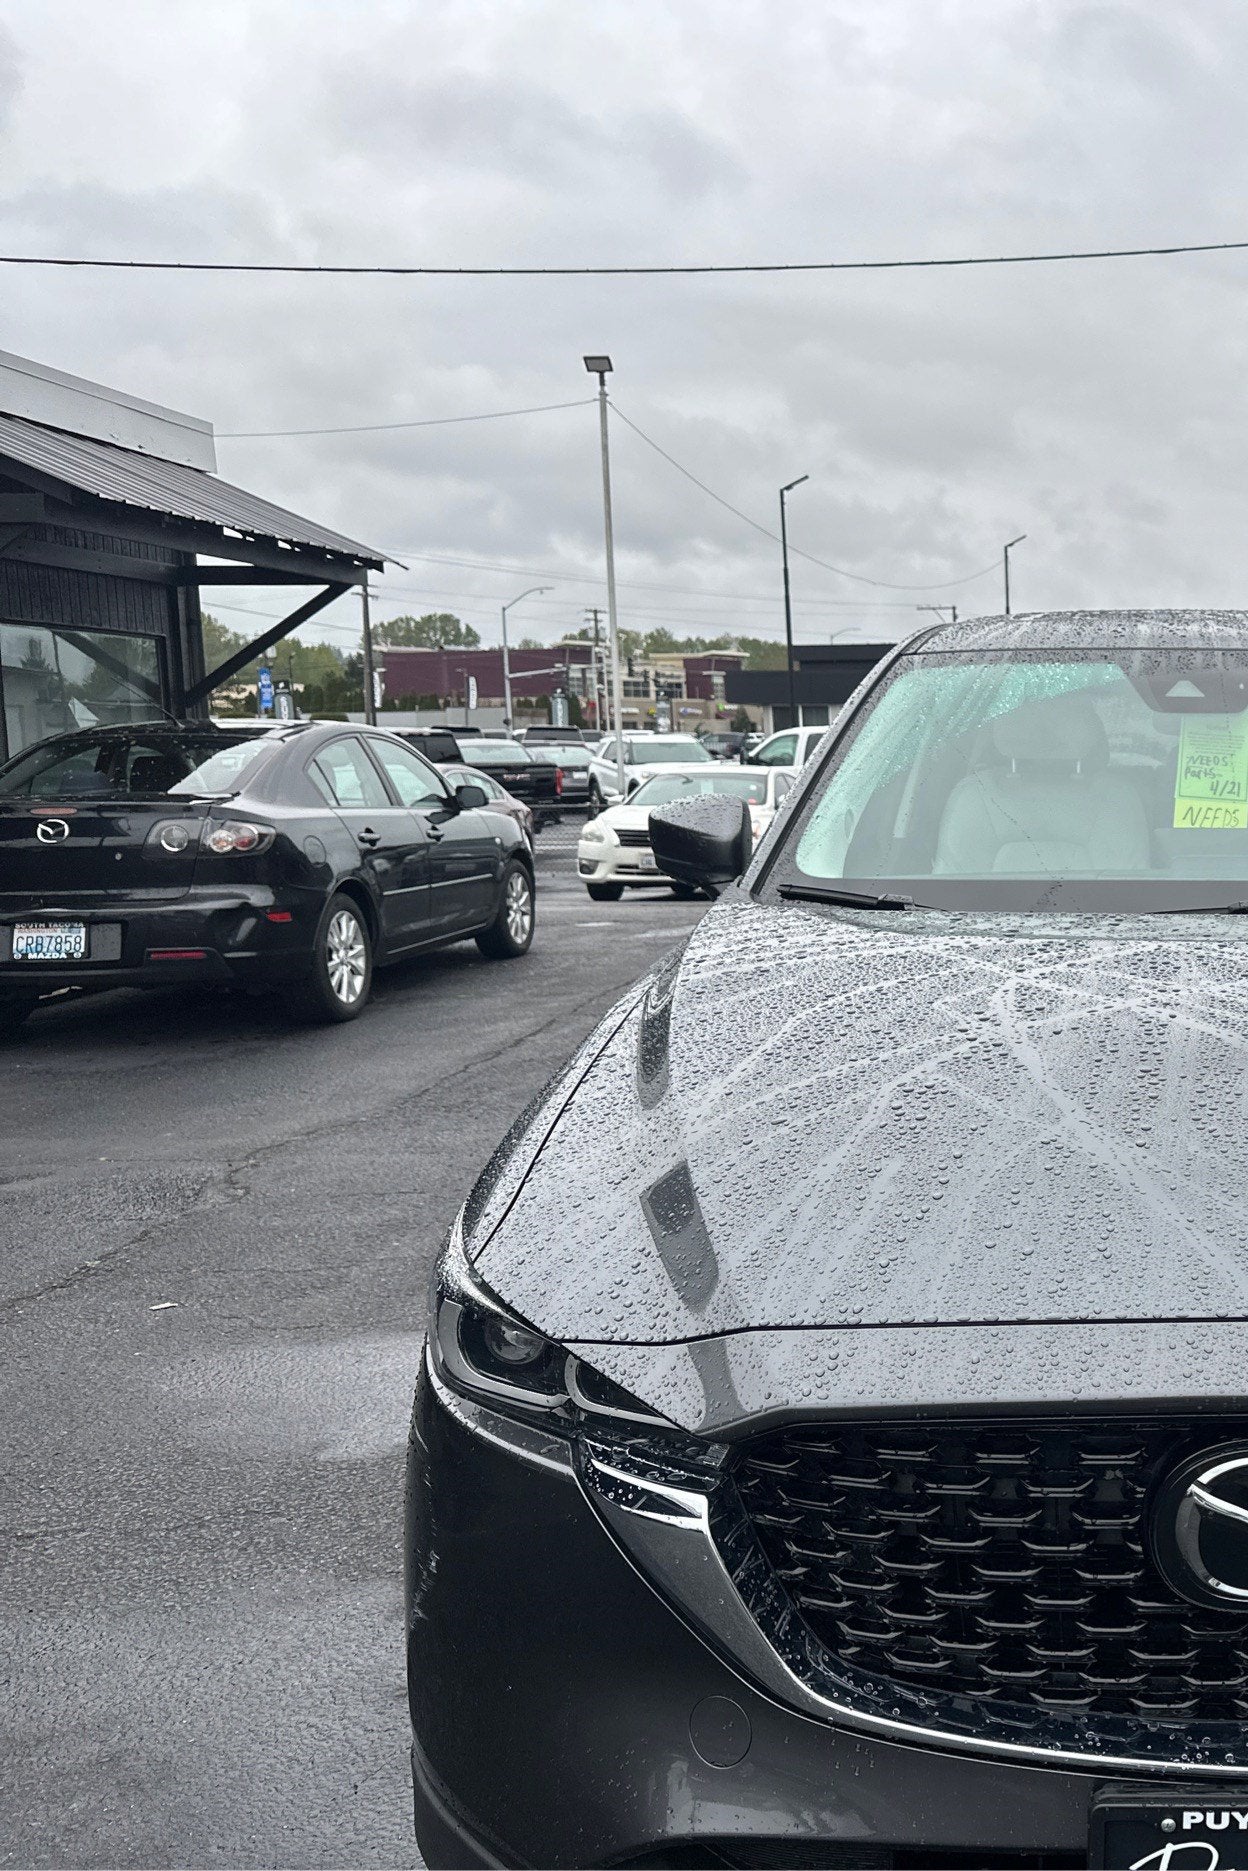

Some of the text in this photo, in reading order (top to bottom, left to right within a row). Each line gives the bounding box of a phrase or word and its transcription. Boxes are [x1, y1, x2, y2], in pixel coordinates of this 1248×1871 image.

[1186, 755, 1230, 767] NEEDS
[1210, 780, 1241, 797] 4/21
[15, 935, 83, 954] CRB7858
[27, 952, 68, 960] MAZDA
